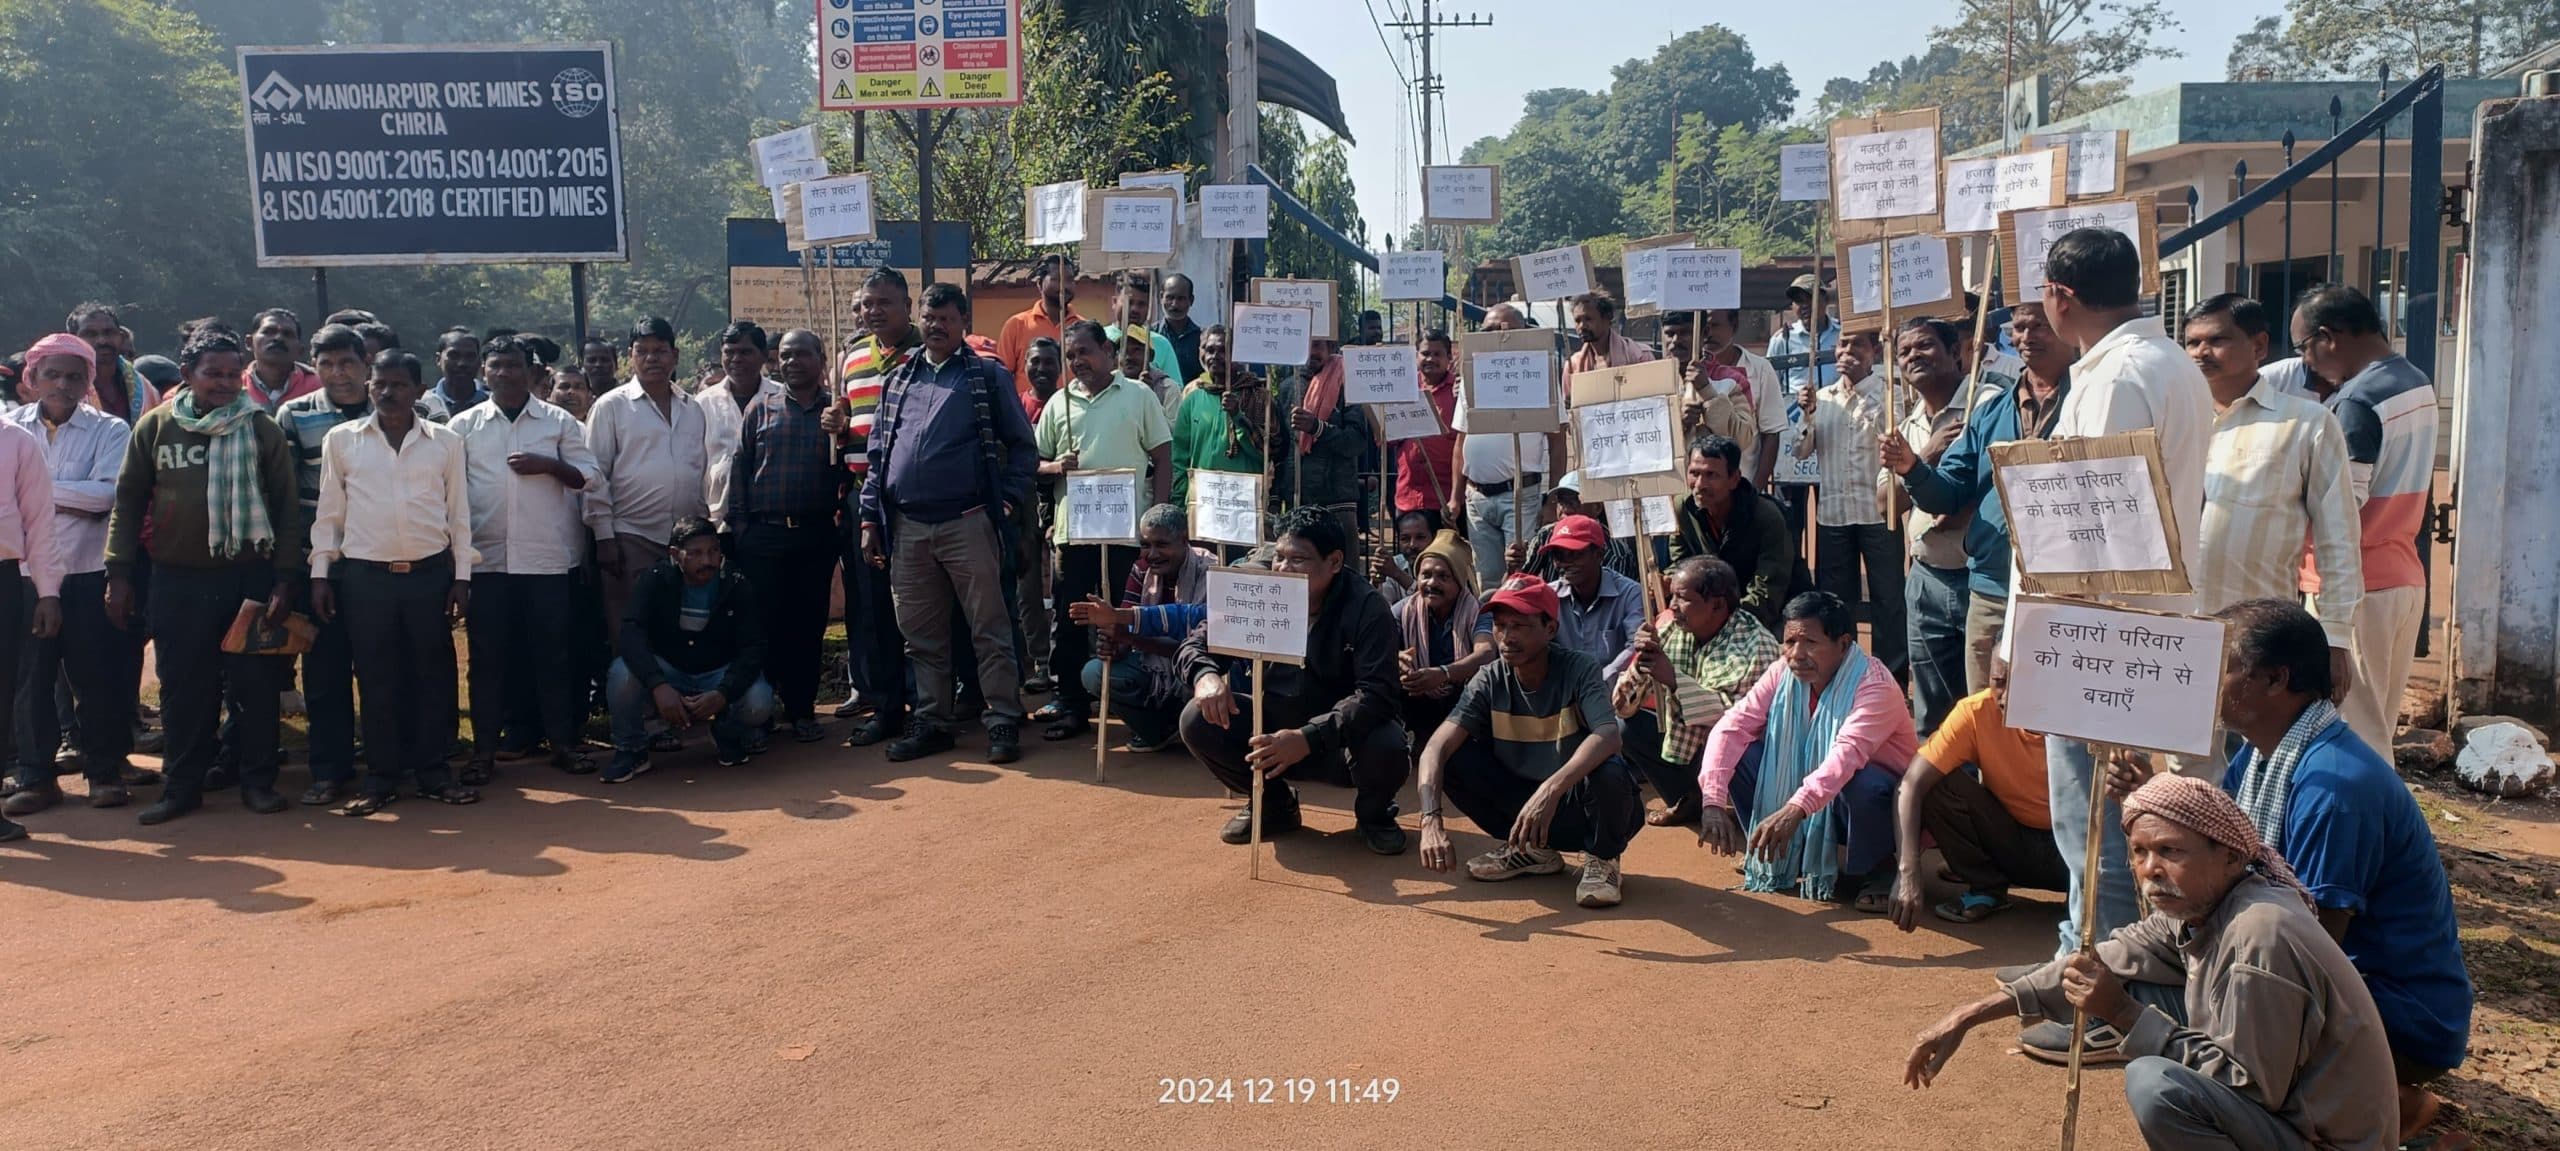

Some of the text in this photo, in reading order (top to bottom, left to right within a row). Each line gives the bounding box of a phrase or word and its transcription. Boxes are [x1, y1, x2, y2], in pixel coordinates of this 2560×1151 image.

[964, 11, 1001, 20] protection
[870, 78, 902, 88] Danger
[960, 72, 992, 82] Danger
[551, 82, 604, 102] ISO
[890, 88, 912, 97] work
[964, 82, 988, 90] Deep
[304, 80, 543, 110] MANOHARPUR ORE MINES
[950, 91, 1002, 100] excavations
[281, 112, 306, 125] SAIL
[380, 112, 448, 136] CHIRIA
[1860, 138, 1908, 156] मजदूरों की
[262, 152, 293, 182] AN
[296, 151, 332, 182] ISO
[1854, 158, 1916, 174] जिम्मेदारी सेल
[1882, 177, 1894, 190] को
[1900, 175, 1919, 189] लेनी
[262, 190, 280, 222] &
[282, 190, 318, 221] ISO
[442, 187, 544, 218] CERTIFIED
[550, 186, 608, 217] MINES
[1876, 196, 1896, 210] होगी
[2090, 212, 2105, 227] की
[1910, 240, 1920, 250] की
[1913, 255, 1929, 266] सेल
[1898, 268, 1934, 284] को लेनी
[1390, 350, 1402, 362] की
[1520, 356, 1530, 366] की
[1354, 366, 1386, 378] मनमानी
[1594, 408, 1616, 426] सेल
[1592, 426, 1662, 450] होश में आओ
[157, 444, 209, 470] ALC
[2074, 470, 2124, 489] परिवार
[2024, 494, 2139, 518] को बेघर होने से
[2066, 522, 2106, 543] बचाएँ
[1232, 582, 1282, 597] मजदूरों की
[1226, 595, 1289, 614] जिम्मेदारी सेल
[1253, 616, 1266, 629] को
[1270, 616, 1290, 631] लेनी
[1244, 631, 1264, 645] होगी
[2048, 620, 2185, 652] हज़ारों परिवार
[2034, 646, 2194, 686] को बेघर होने से
[2082, 686, 2136, 713] बचाएँ
